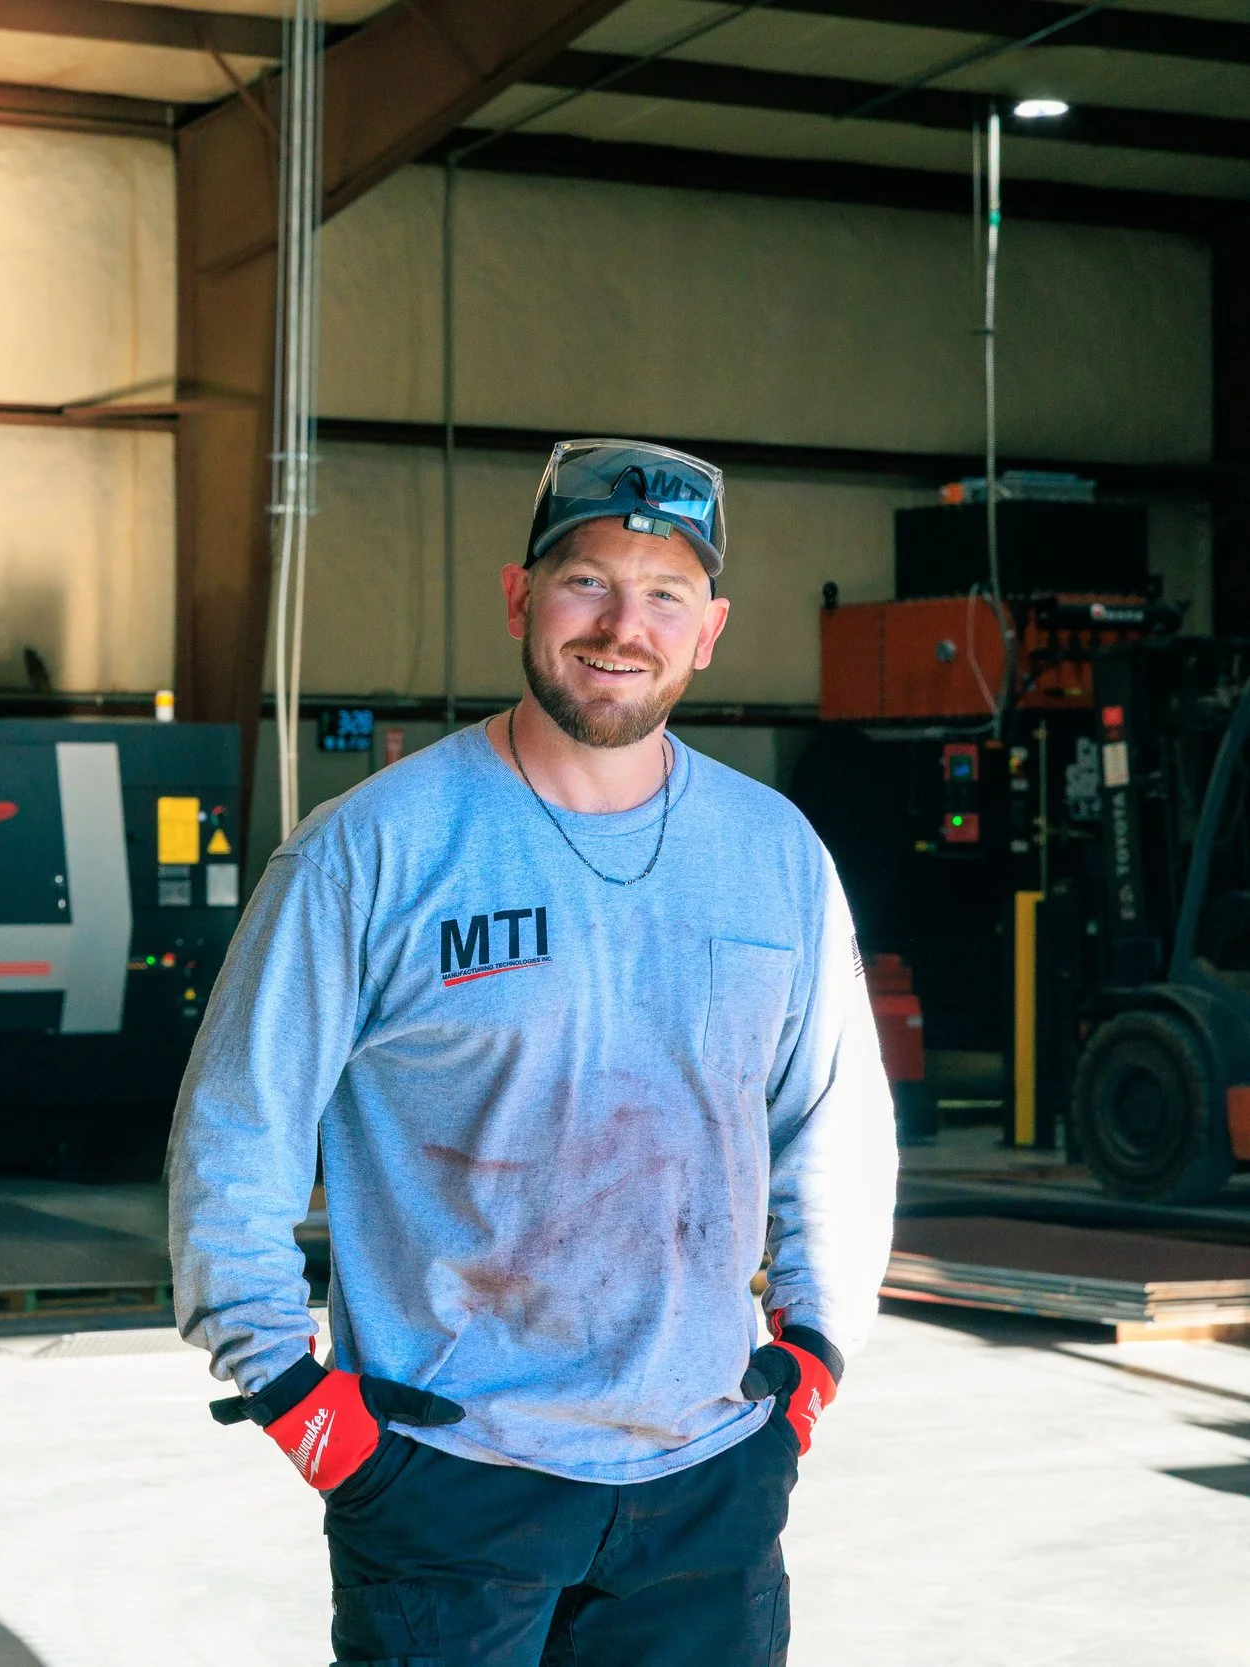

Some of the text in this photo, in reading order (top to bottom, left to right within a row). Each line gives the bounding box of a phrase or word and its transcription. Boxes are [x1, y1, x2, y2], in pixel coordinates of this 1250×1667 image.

[651, 468, 709, 501] MT
[440, 907, 548, 974] MTI
[441, 964, 494, 980] MANUFACTURING
[495, 957, 541, 969] TECHNOLOGIES
